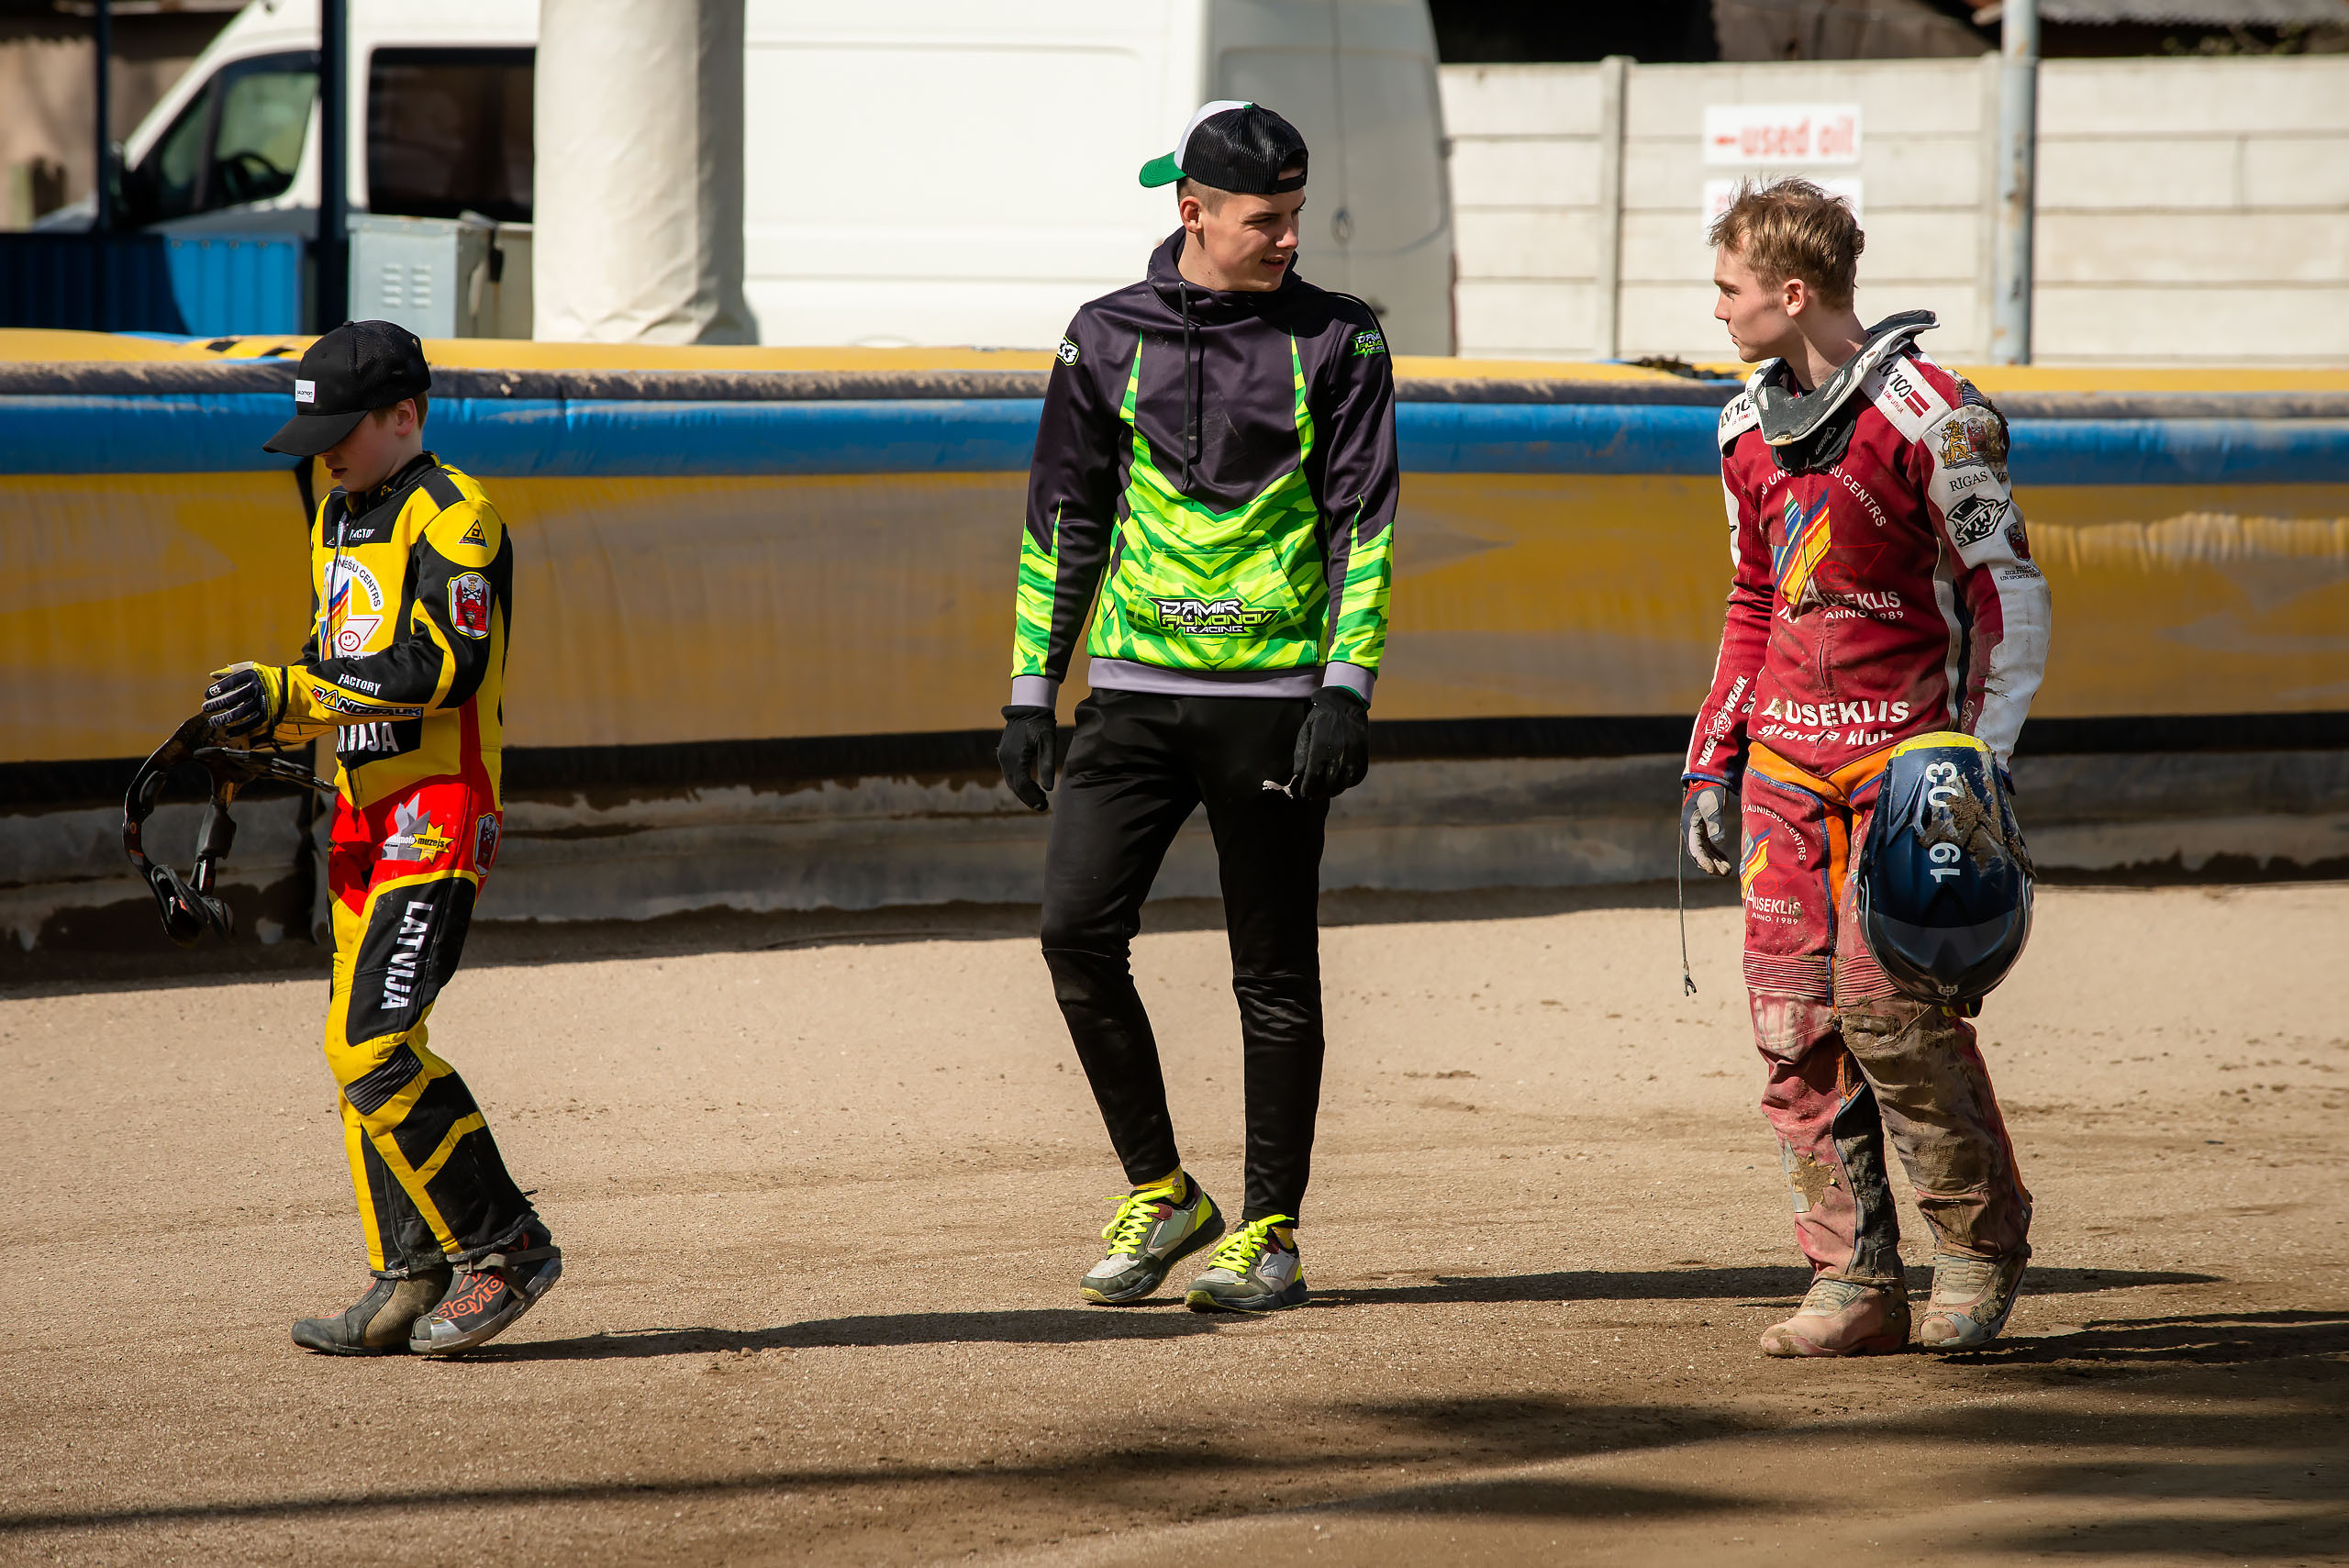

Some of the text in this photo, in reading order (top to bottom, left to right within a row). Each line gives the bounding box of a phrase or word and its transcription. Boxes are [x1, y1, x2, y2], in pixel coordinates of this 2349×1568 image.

[1742, 114, 1854, 157] used oil
[1842, 474, 1887, 528] CENTRS
[359, 569, 381, 607] CENTRS
[1158, 600, 1241, 617] DAMIR
[1824, 609, 1868, 620] ANNO
[1186, 625, 1243, 633] RACING
[338, 673, 382, 695] FACTORY
[1724, 675, 1751, 713] WEAR
[1761, 698, 1910, 727] AUSEKLIS
[417, 838, 445, 849] muzejs
[1745, 883, 1802, 917] AUSEKLIS
[1776, 916, 1798, 926] 1989
[381, 901, 433, 1009] LATVIJA
